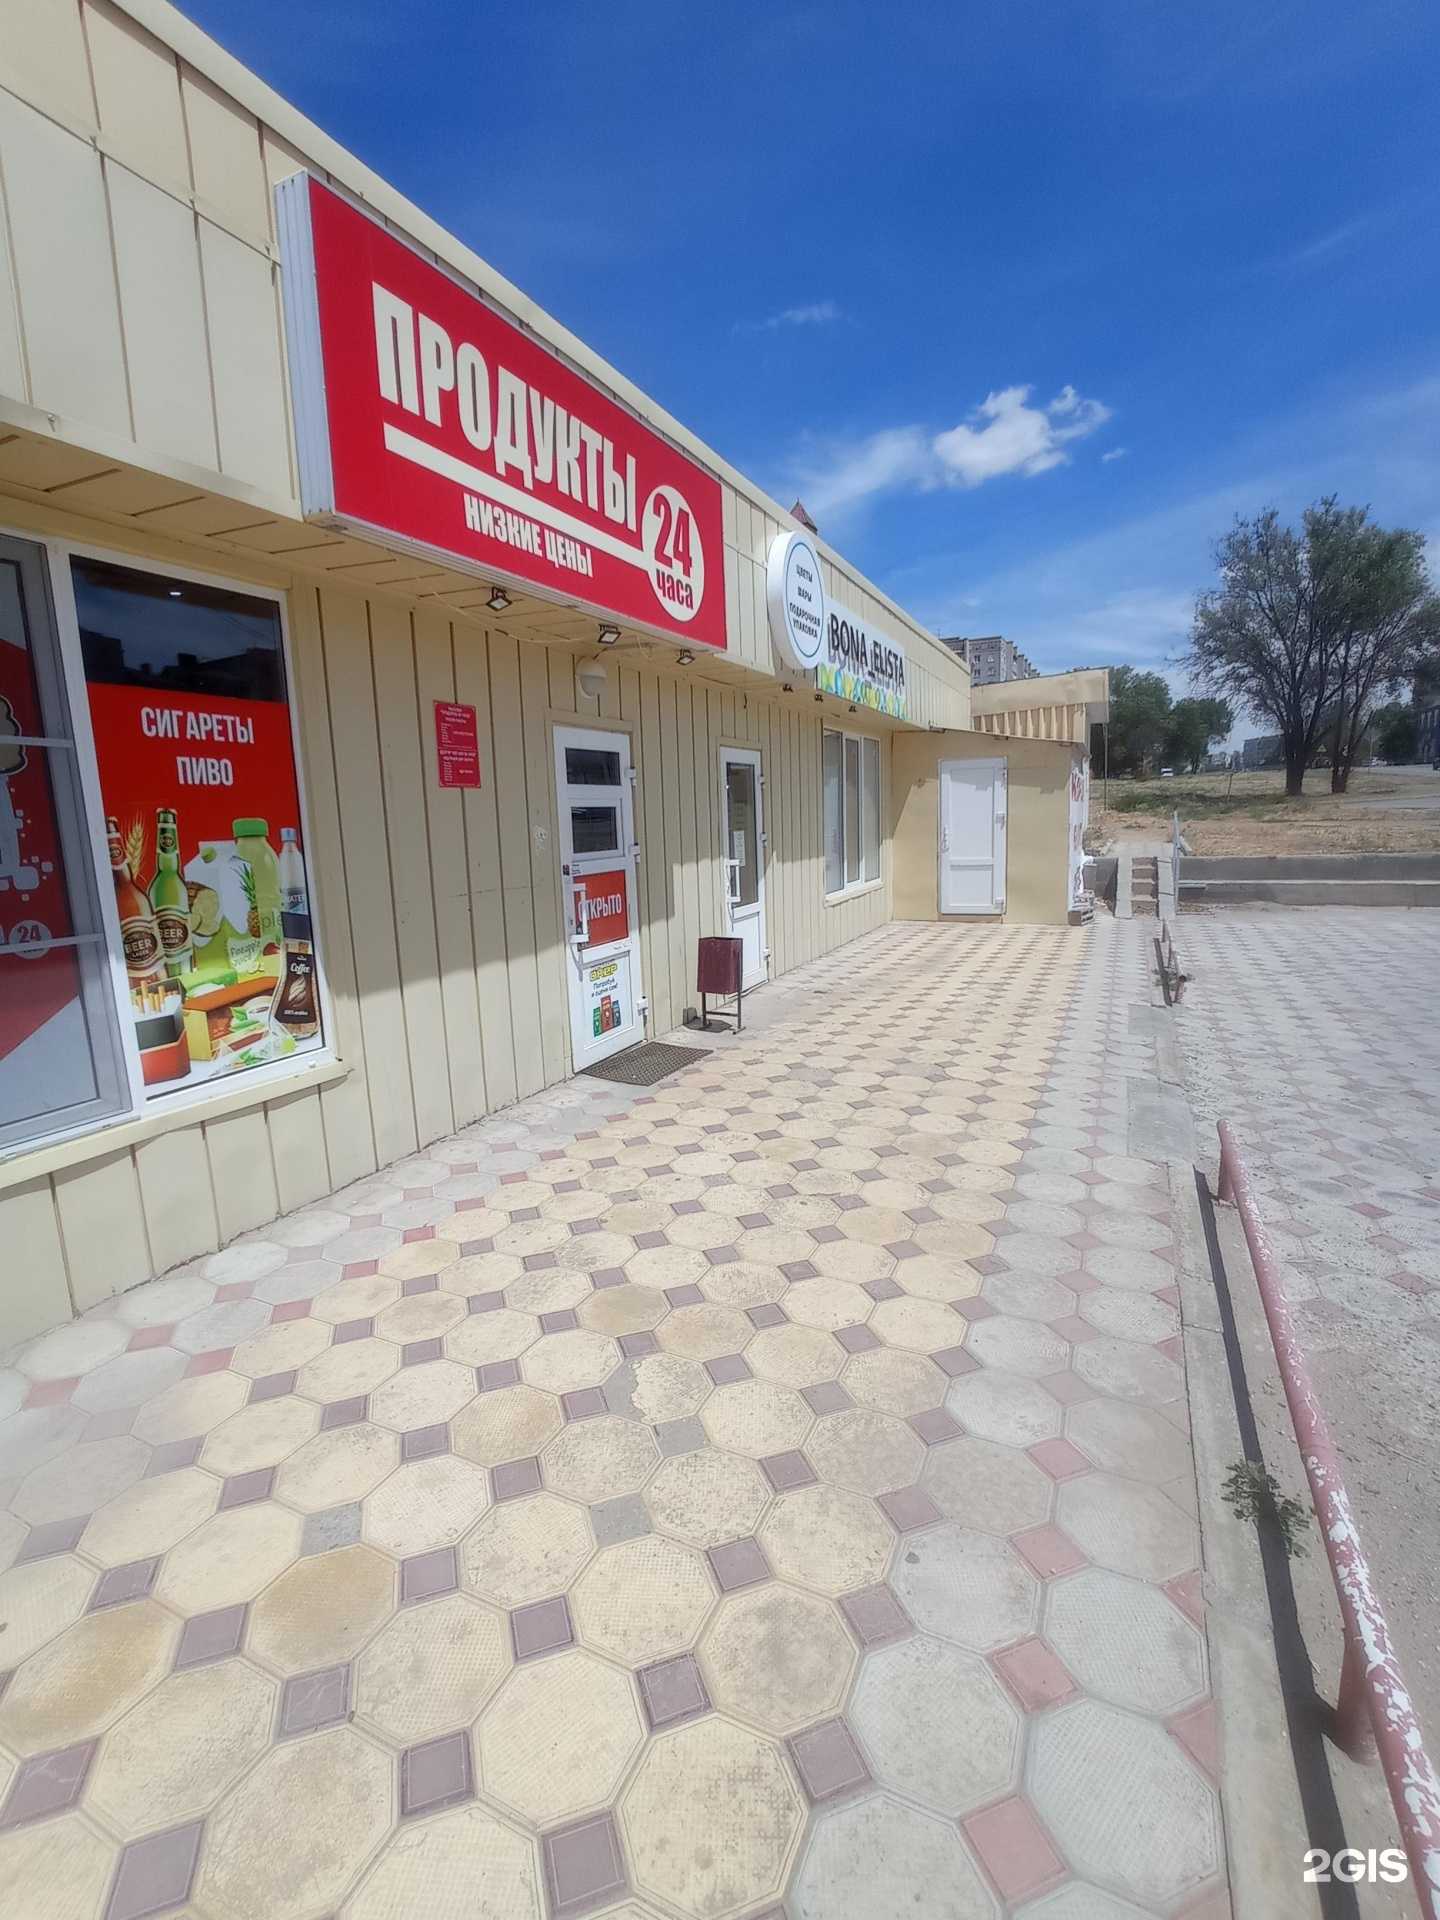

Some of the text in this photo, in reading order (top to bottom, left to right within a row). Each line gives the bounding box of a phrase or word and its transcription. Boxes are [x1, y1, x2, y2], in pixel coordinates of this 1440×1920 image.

[373, 281, 637, 533] ПРОДУКТЫ
[463, 492, 593, 578] НИЗКИЕ ЦЕНЫ
[653, 493, 692, 578] 24
[656, 568, 694, 610] часа
[176, 756, 234, 786] ПИВО
[18, 924, 42, 944] 24
[125, 938, 153, 954] BEER
[290, 962, 311, 975] Coffee
